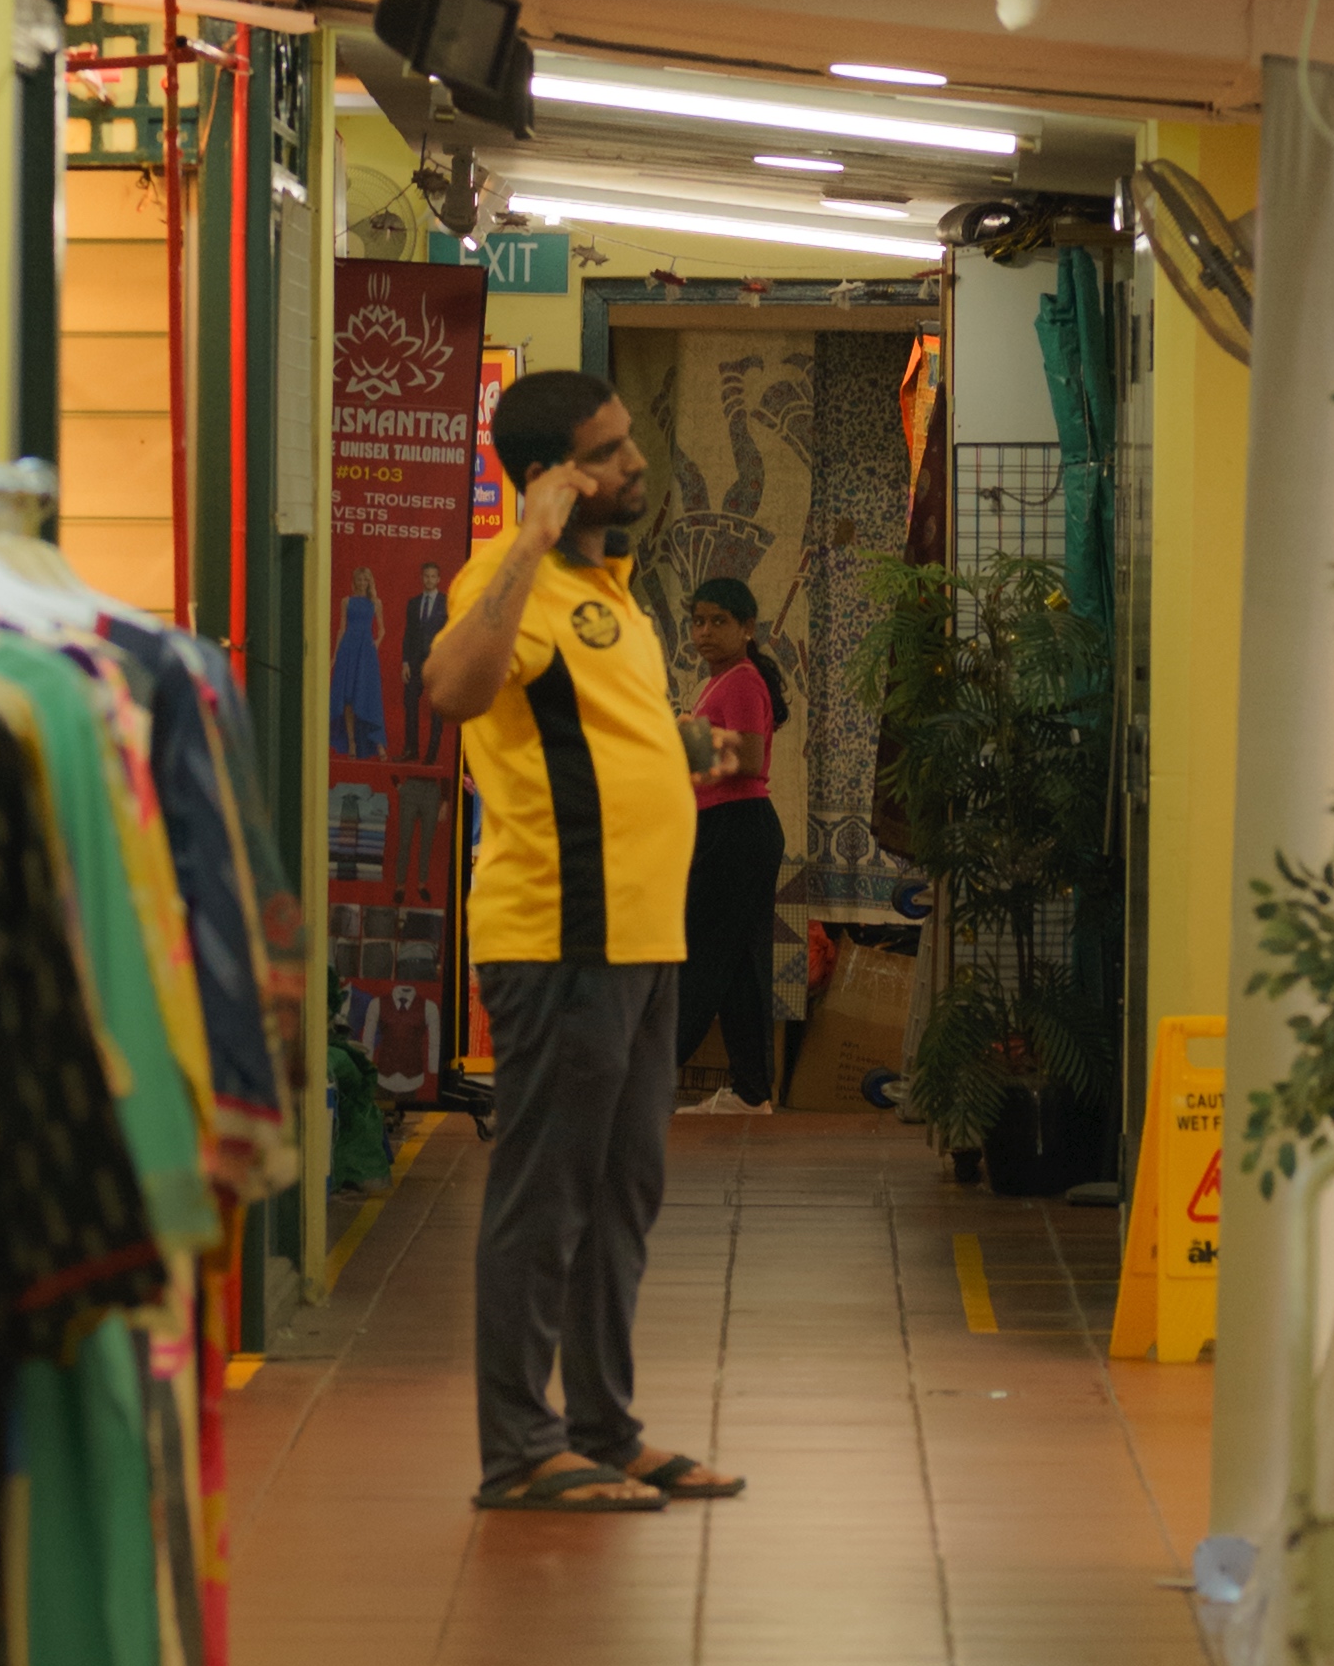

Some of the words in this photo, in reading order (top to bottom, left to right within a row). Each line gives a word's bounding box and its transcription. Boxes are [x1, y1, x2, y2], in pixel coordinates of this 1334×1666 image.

[340, 441, 390, 460] UNISEX
[393, 444, 465, 464] TAILORING
[336, 465, 403, 482] #01-03
[364, 492, 456, 510] TROUSERS
[333, 506, 388, 521] VESTS
[362, 523, 442, 540] DRESSES
[1177, 1116, 1209, 1131] WET
[1213, 1116, 1222, 1131] F
